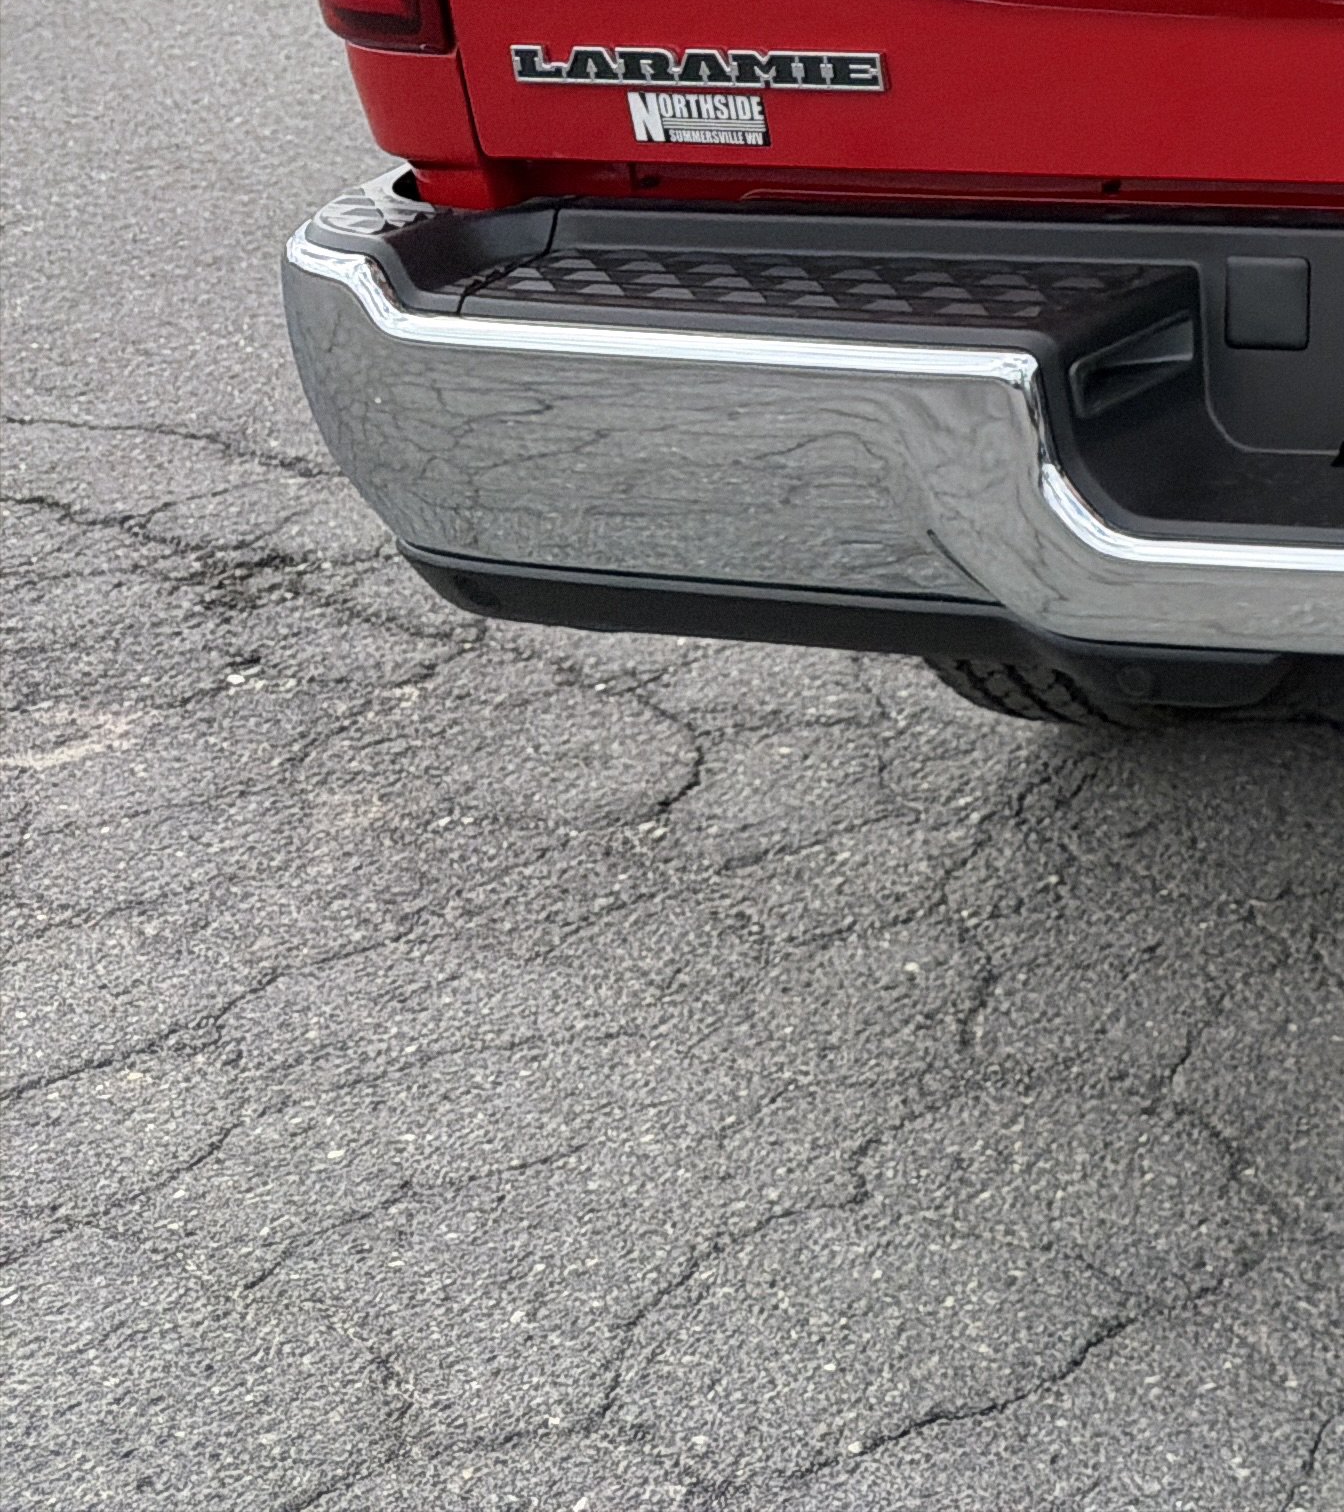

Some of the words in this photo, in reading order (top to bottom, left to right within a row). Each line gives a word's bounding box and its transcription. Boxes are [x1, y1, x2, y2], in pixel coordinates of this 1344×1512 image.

[510, 43, 886, 92] LARAMIE
[627, 91, 765, 142] NORTHSIDE
[669, 128, 744, 145] SUMMERSVILLE
[745, 131, 764, 145] WV
